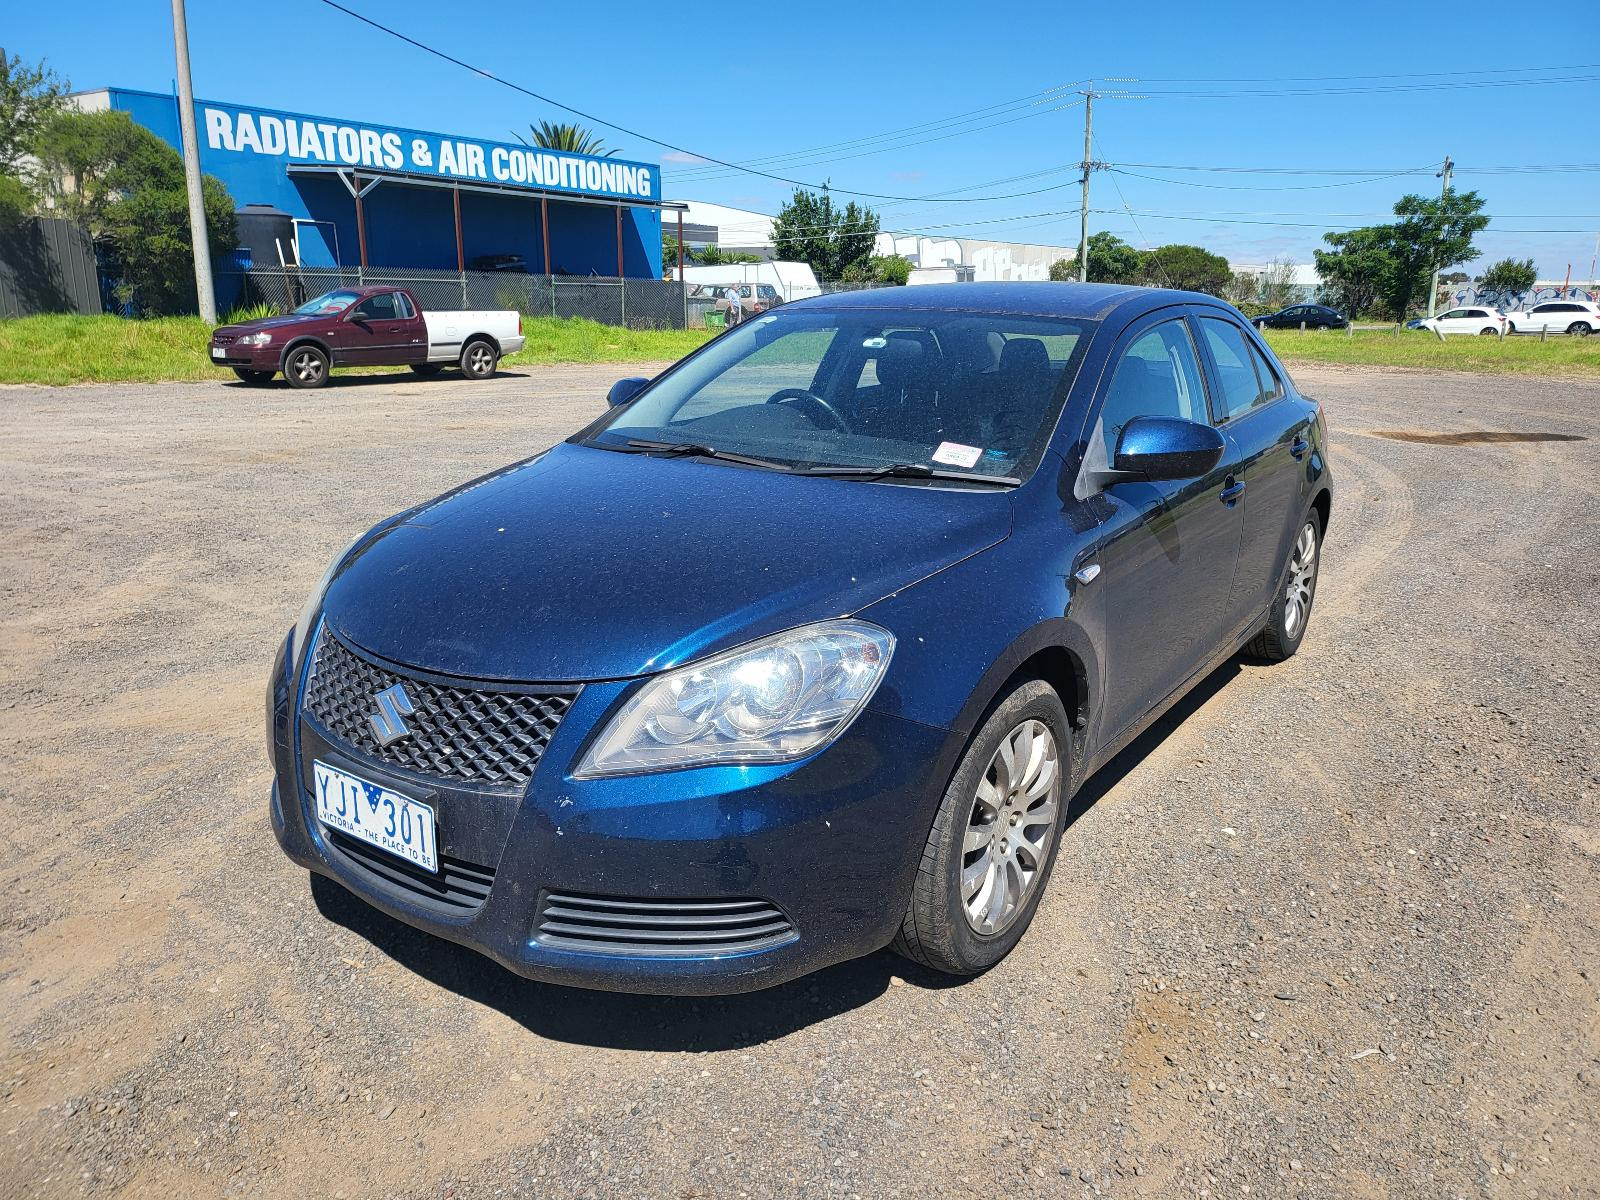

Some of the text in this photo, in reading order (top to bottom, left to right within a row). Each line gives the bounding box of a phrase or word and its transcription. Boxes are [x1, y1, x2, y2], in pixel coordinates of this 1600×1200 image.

[204, 108, 651, 197] RADIATORS & AIR CONDITIONING
[317, 771, 426, 853] YJI 301
[322, 810, 355, 832] VICTORIA
[365, 828, 379, 842] THE
[382, 836, 405, 854] PLACE
[408, 847, 419, 860] TO
[421, 855, 431, 867] BE
